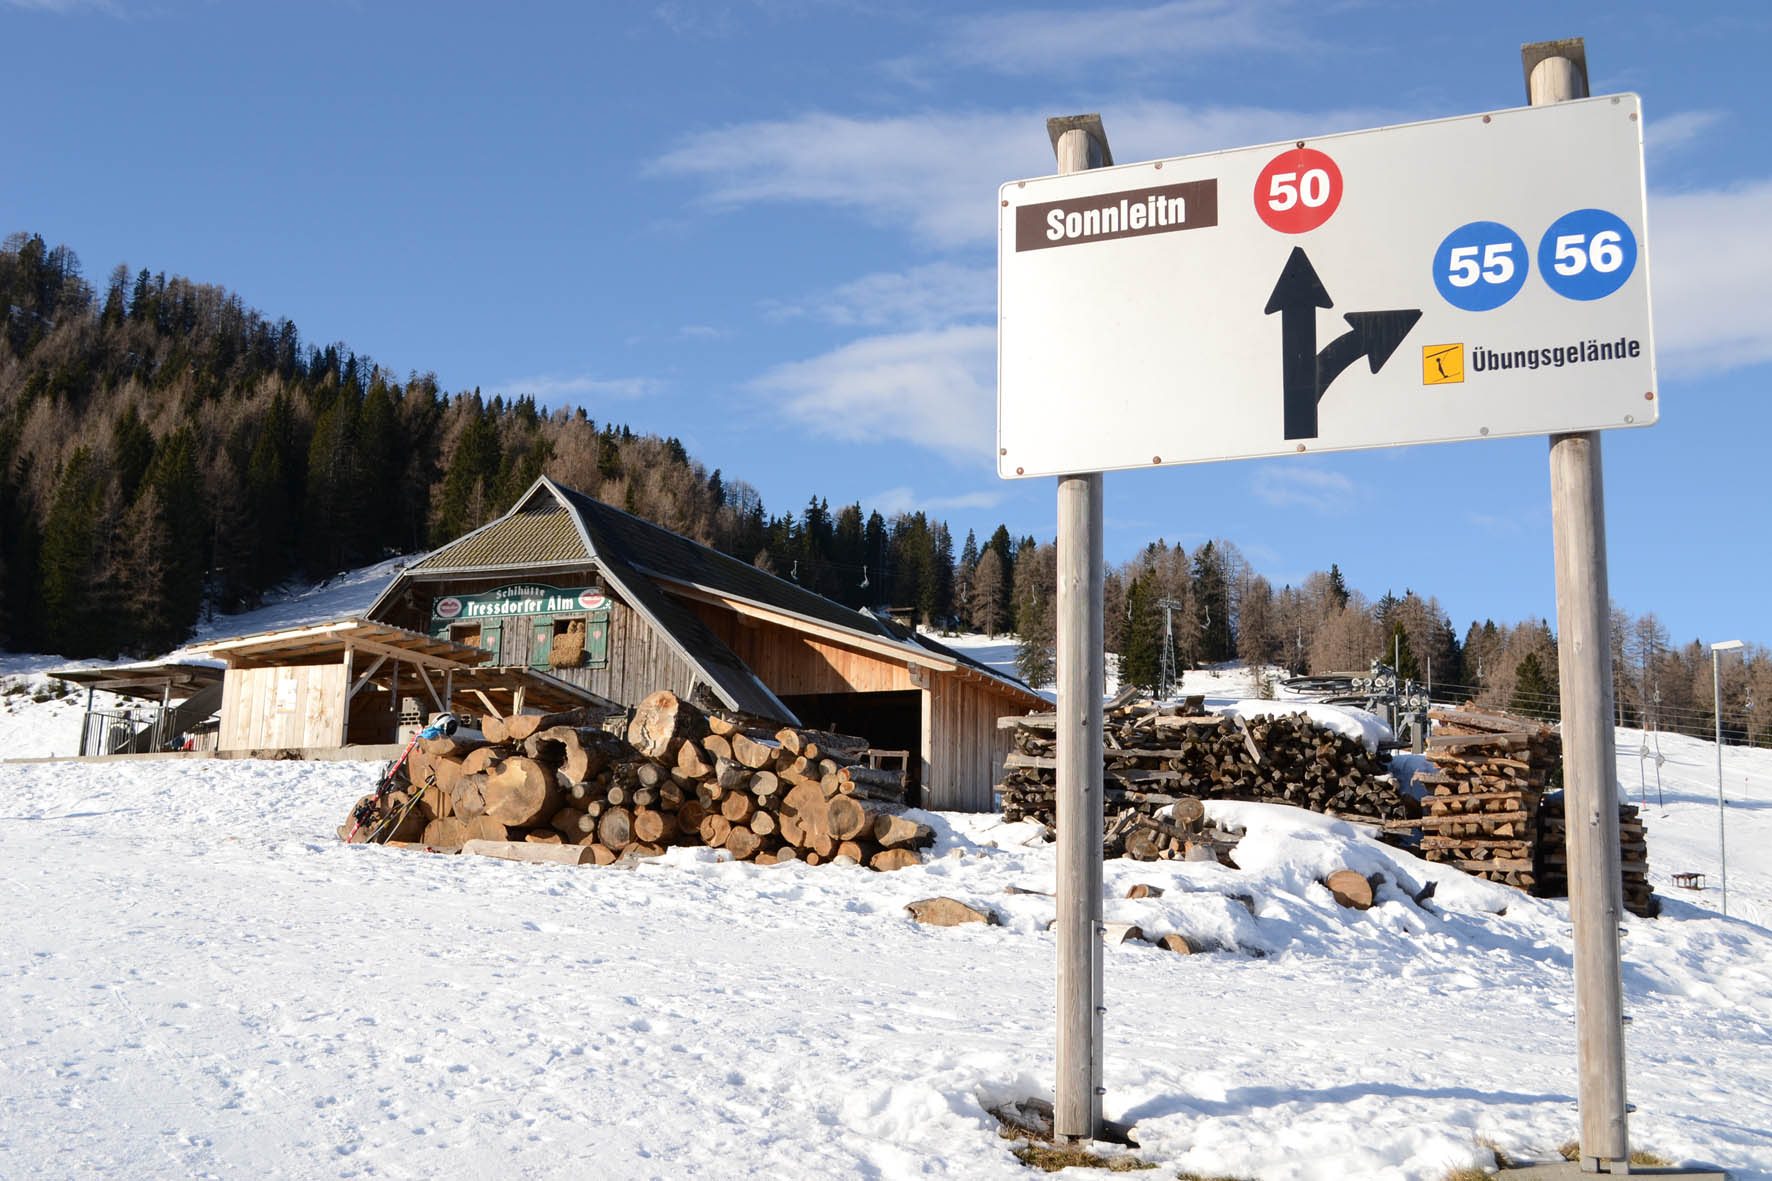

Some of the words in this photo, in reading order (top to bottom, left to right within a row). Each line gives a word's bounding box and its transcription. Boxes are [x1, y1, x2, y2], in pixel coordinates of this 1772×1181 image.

[1268, 168, 1330, 212] 50
[1046, 195, 1186, 241] Sonnleitn
[1448, 242, 1515, 287] 55
[1554, 230, 1623, 276] 56
[1472, 337, 1641, 372] Übungsgelände
[467, 597, 543, 617] Tressdorfer
[547, 595, 574, 611] Alm
[496, 585, 546, 599] Schihütte
